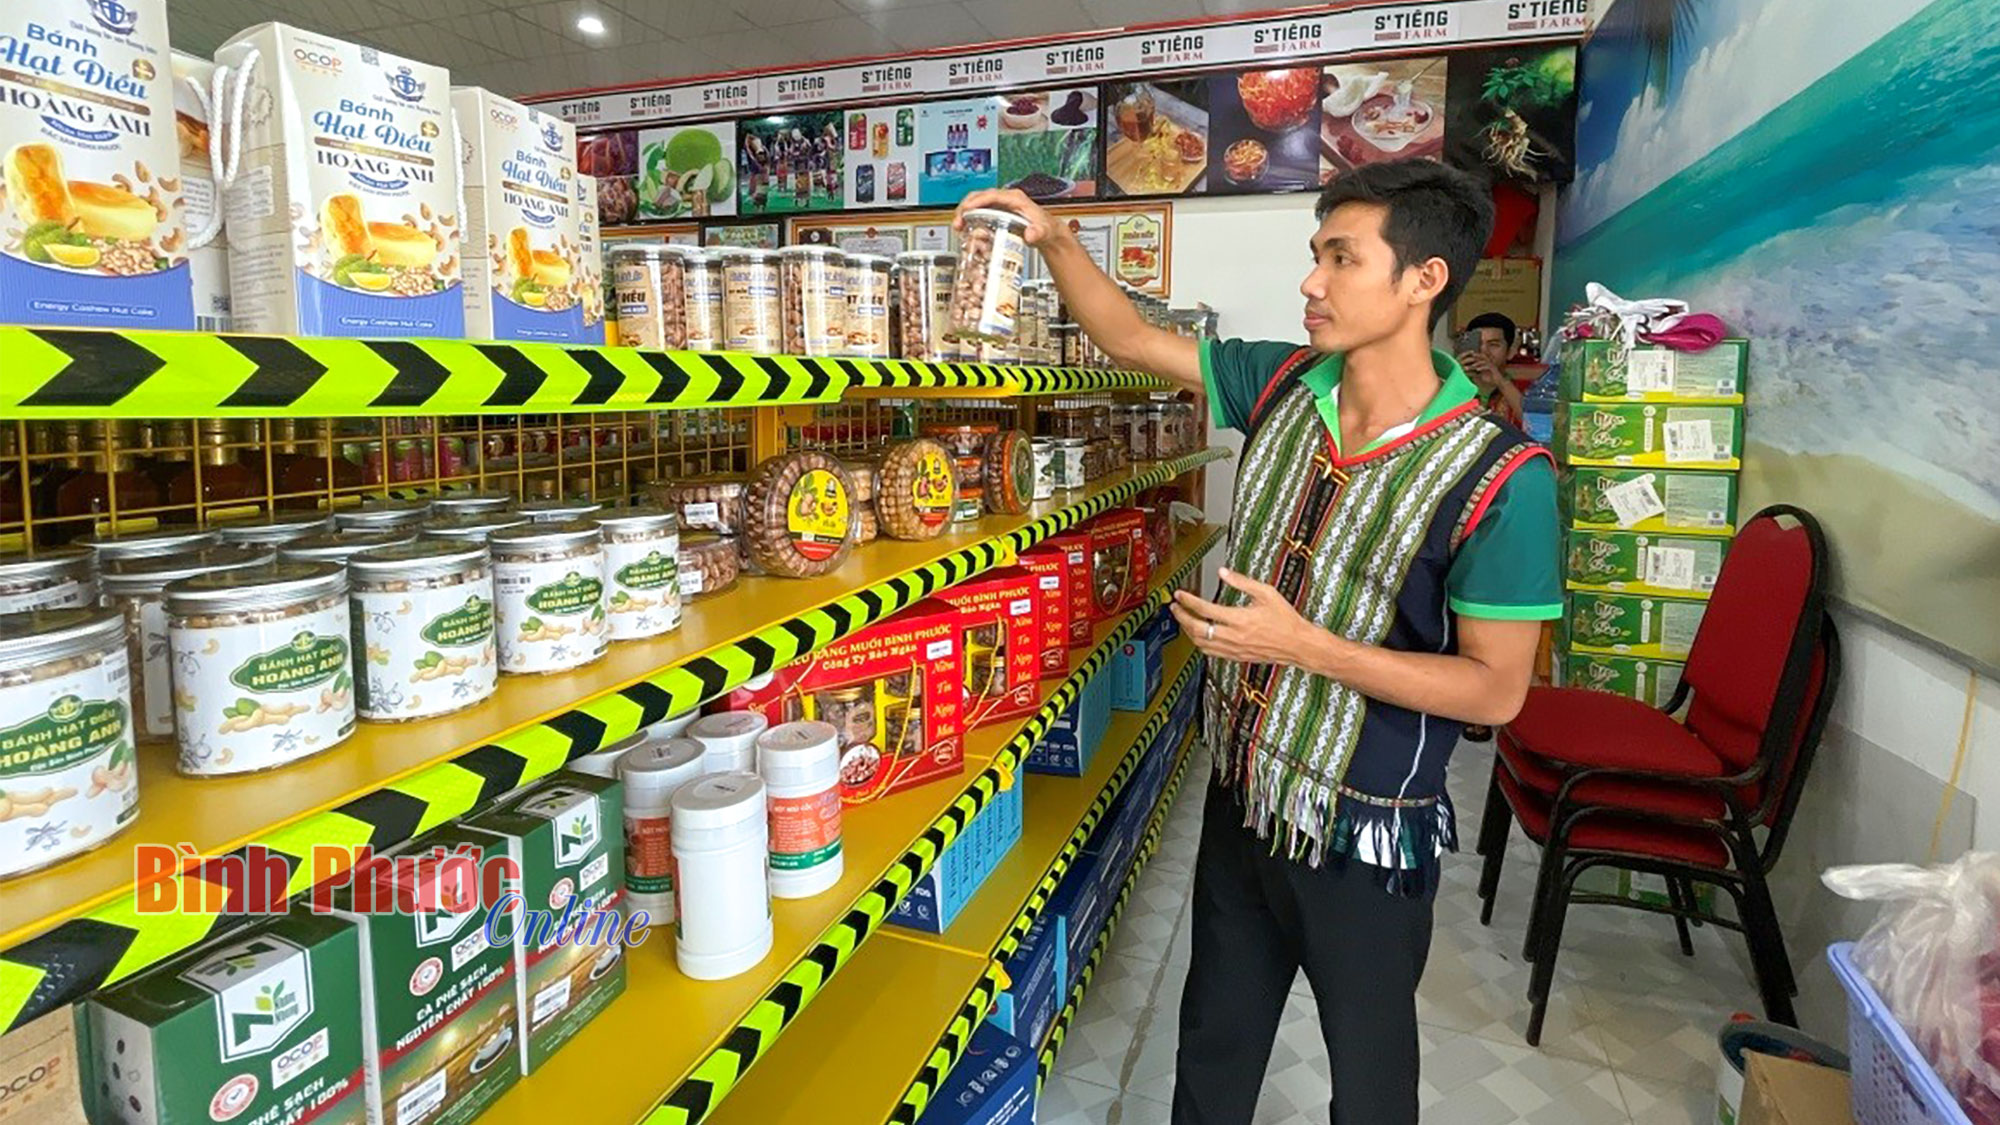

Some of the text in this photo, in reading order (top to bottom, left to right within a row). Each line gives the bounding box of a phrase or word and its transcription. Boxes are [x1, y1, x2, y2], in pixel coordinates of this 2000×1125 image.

[1540, 17, 1586, 28] FARM
[27, 23, 97, 57] Bánh
[1404, 29, 1447, 40] FARM
[1282, 40, 1321, 51] FARM
[294, 48, 342, 68] OCOP
[1167, 52, 1203, 62] FARM
[1070, 63, 1104, 73] FARM
[883, 82, 912, 90] FARM
[971, 74, 1003, 83] FARM
[340, 99, 394, 122] Bánh
[104, 113, 150, 137] ANH
[313, 110, 368, 141] Hạt
[317, 151, 390, 176] HOÀNG
[397, 166, 433, 183] ANH
[516, 150, 546, 168] Bánh
[34, 301, 154, 316] Energy Cashew Nut Cake
[342, 316, 368, 326] Energy
[972, 591, 997, 603] BÌNH
[850, 637, 882, 654] MUỐI
[884, 632, 913, 646] BÌNH
[915, 623, 952, 640] PHƯỚC
[251, 664, 315, 686] HOÀNG
[319, 653, 343, 671] ANH
[259, 655, 294, 671] BÁNH
[296, 650, 318, 663] HẠT
[822, 658, 850, 671] Công
[852, 655, 866, 665] Ty
[0, 720, 122, 768] HOÀNG ANH
[2, 729, 52, 750] BÁNH
[56, 720, 87, 736] HẠT
[396, 1012, 445, 1051] NGUYÊN
[477, 963, 506, 993] 100%
[277, 1033, 324, 1069] OCOP
[311, 1078, 350, 1111] 100%
